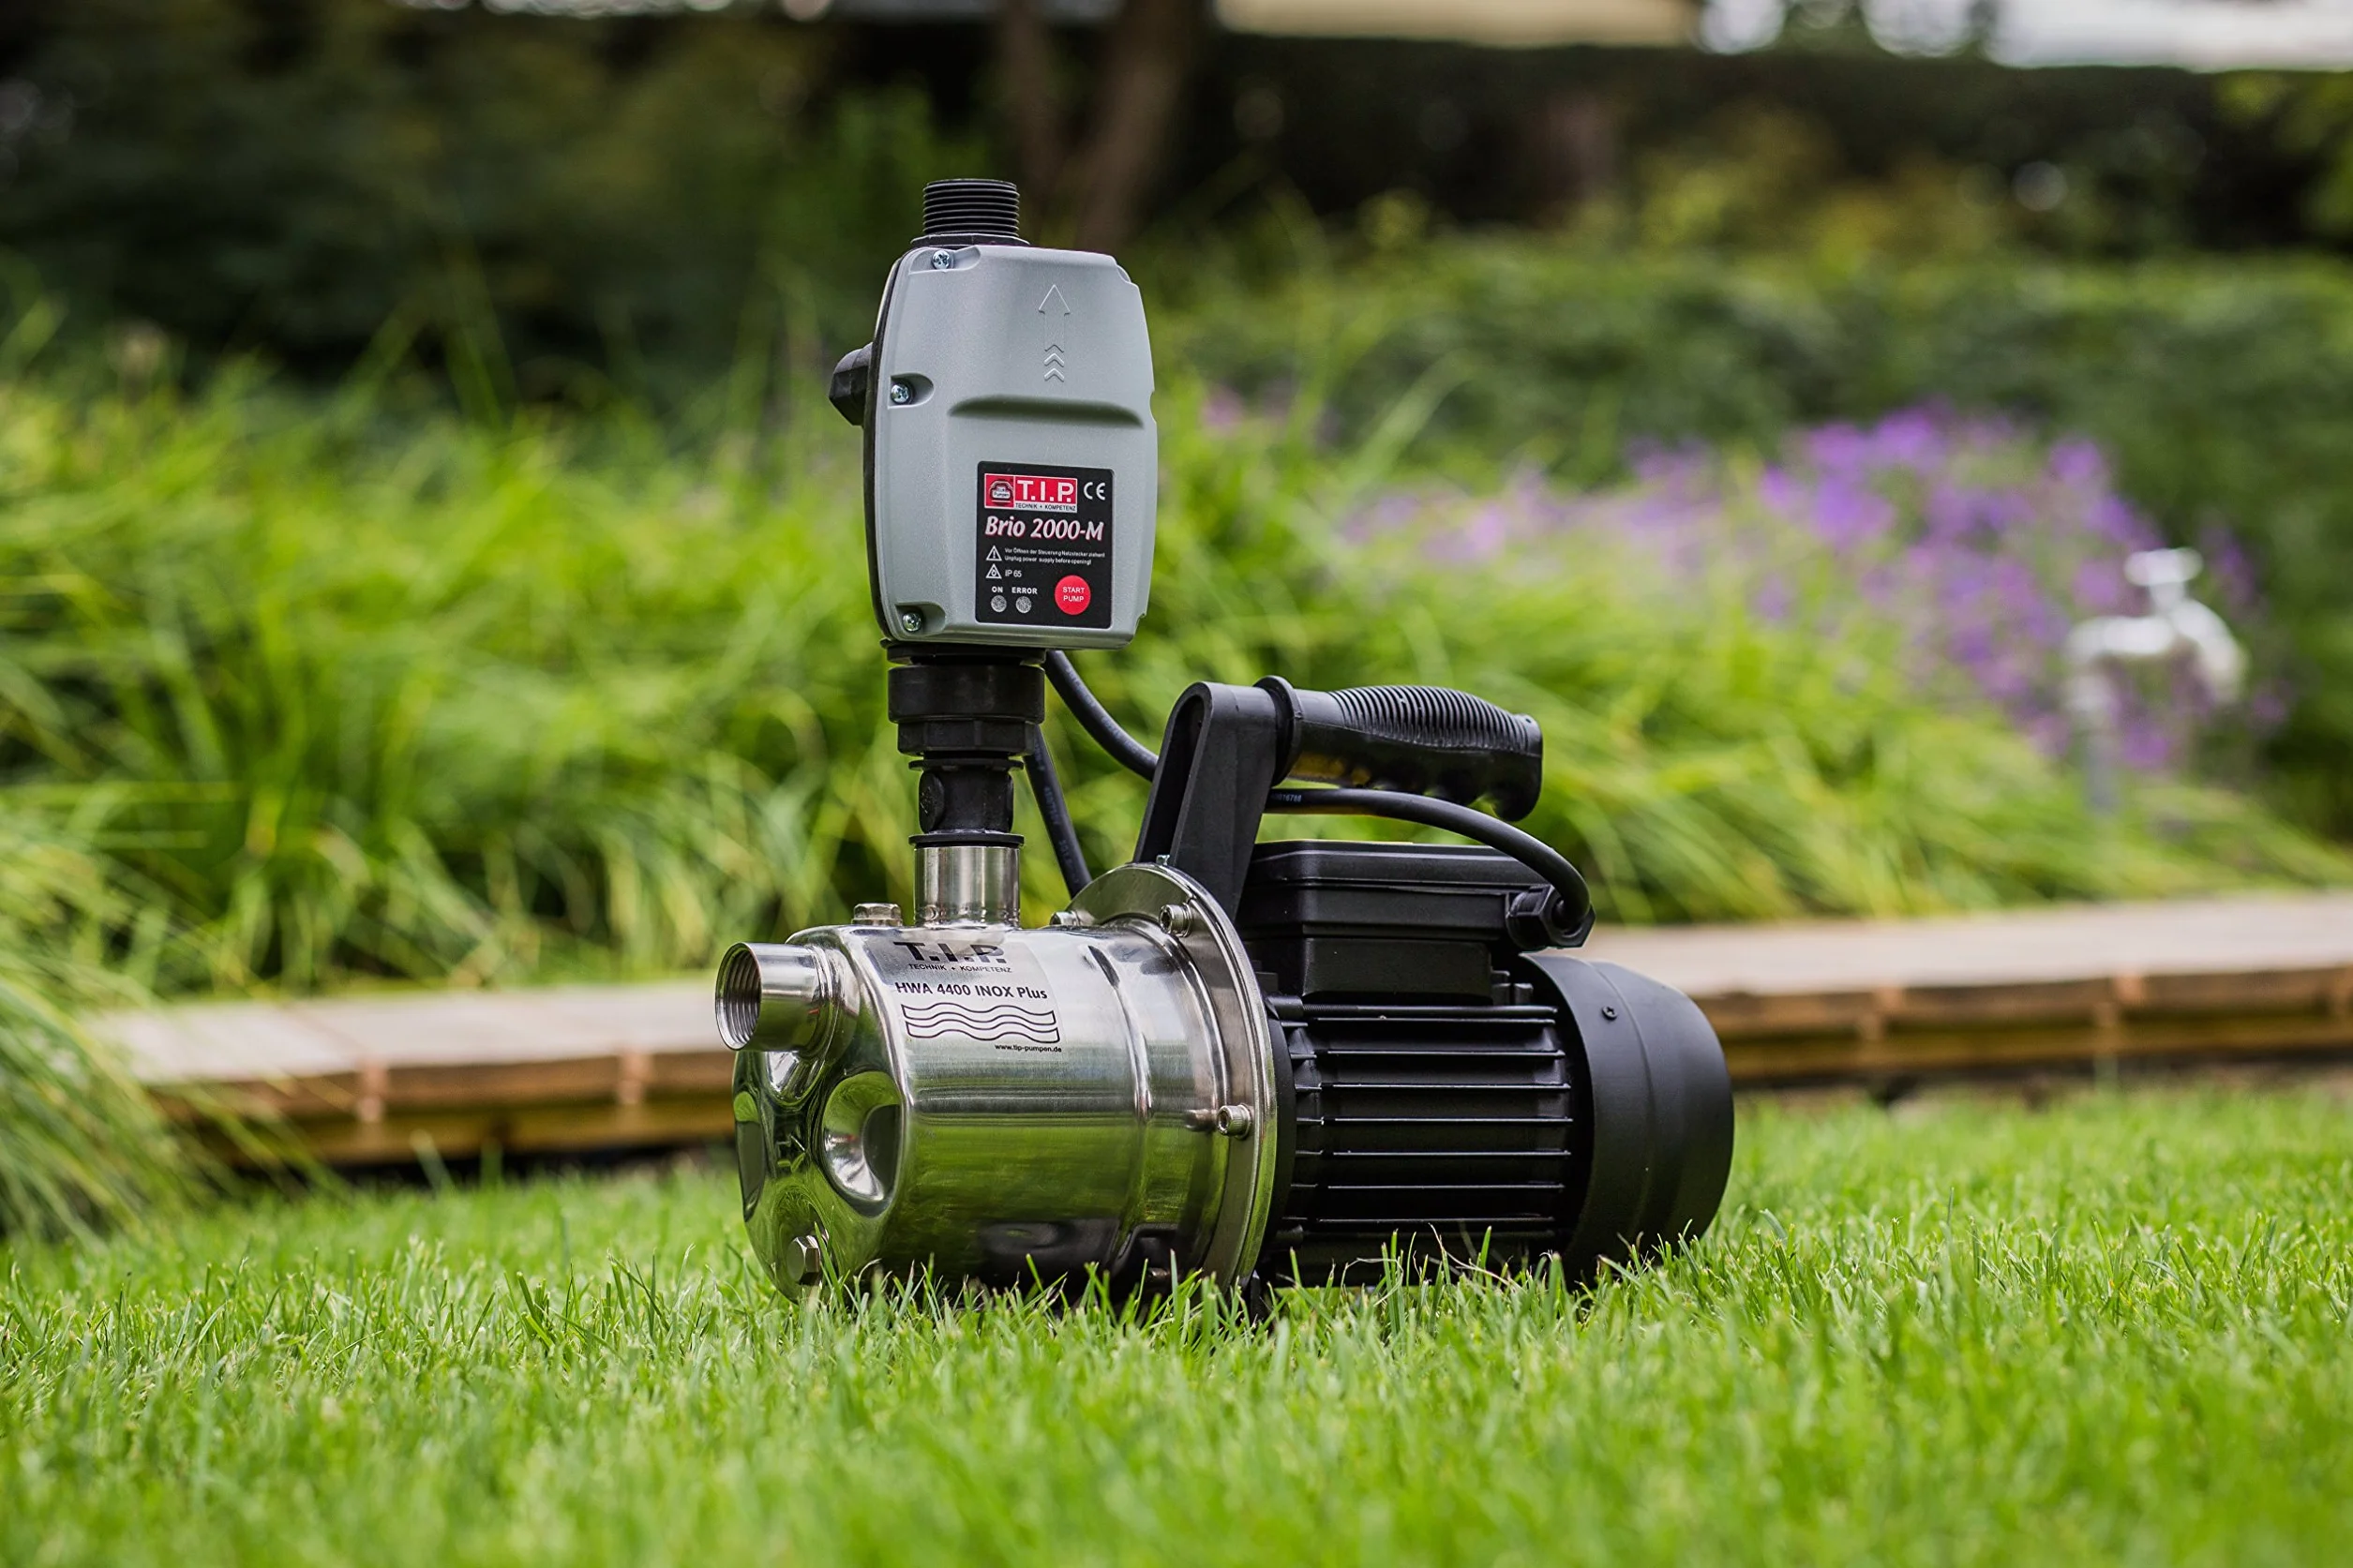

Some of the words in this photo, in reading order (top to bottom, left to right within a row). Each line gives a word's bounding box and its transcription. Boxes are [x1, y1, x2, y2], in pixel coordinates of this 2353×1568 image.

[1017, 480, 1074, 502] T.I.P.
[984, 515, 1026, 537] Brio
[1030, 517, 1104, 541] 2000-M
[893, 941, 1007, 963] T.I.P.
[895, 982, 933, 994] HWA
[937, 984, 971, 996] 4400
[975, 985, 1014, 997] INOX
[1019, 987, 1048, 999] Plus
[995, 1044, 1062, 1053] www.tip-pumpen.de
